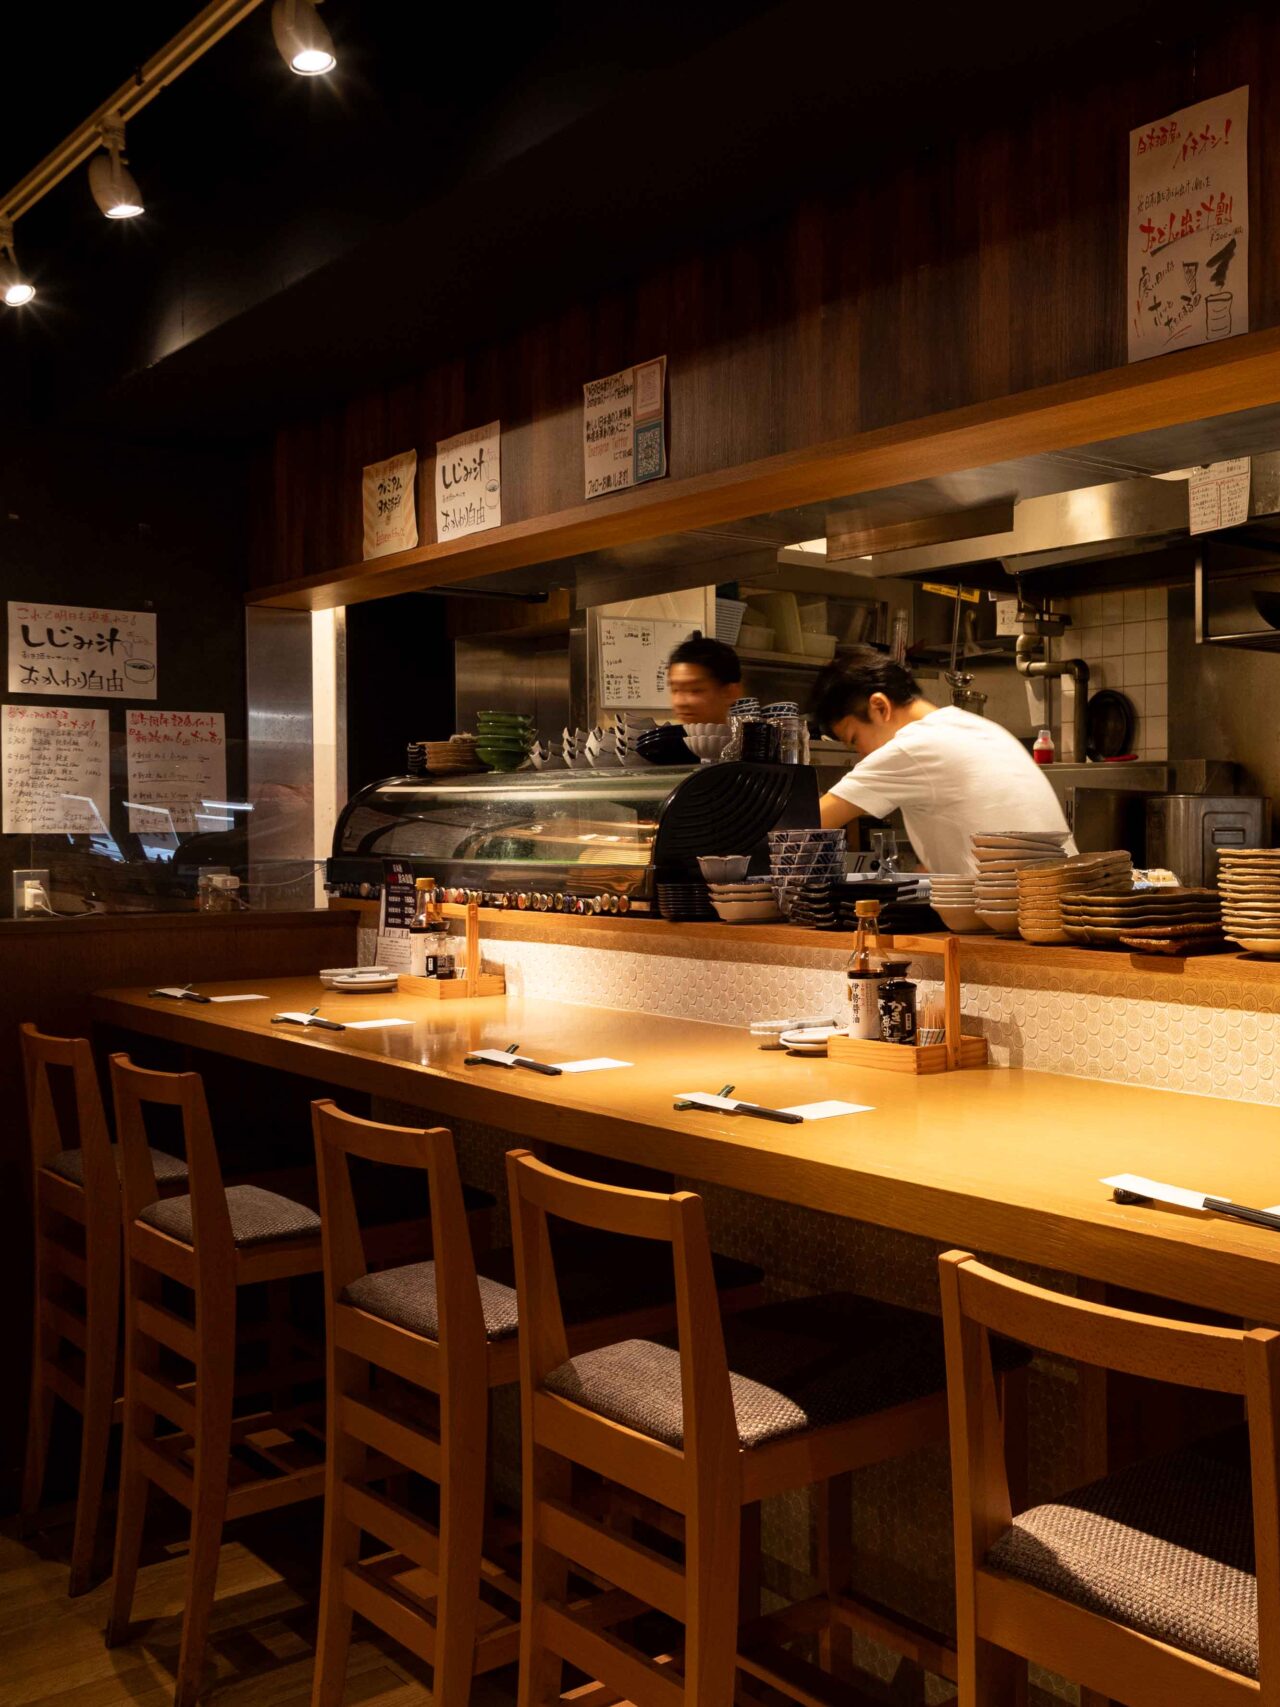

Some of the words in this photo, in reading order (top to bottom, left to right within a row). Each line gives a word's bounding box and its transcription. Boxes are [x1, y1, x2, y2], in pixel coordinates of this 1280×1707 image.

[1138, 191, 1233, 254] おでん出汁割
[441, 447, 485, 490] しじみ汁
[20, 624, 122, 657] しじみ汁
[18, 663, 125, 692] おかわり自由
